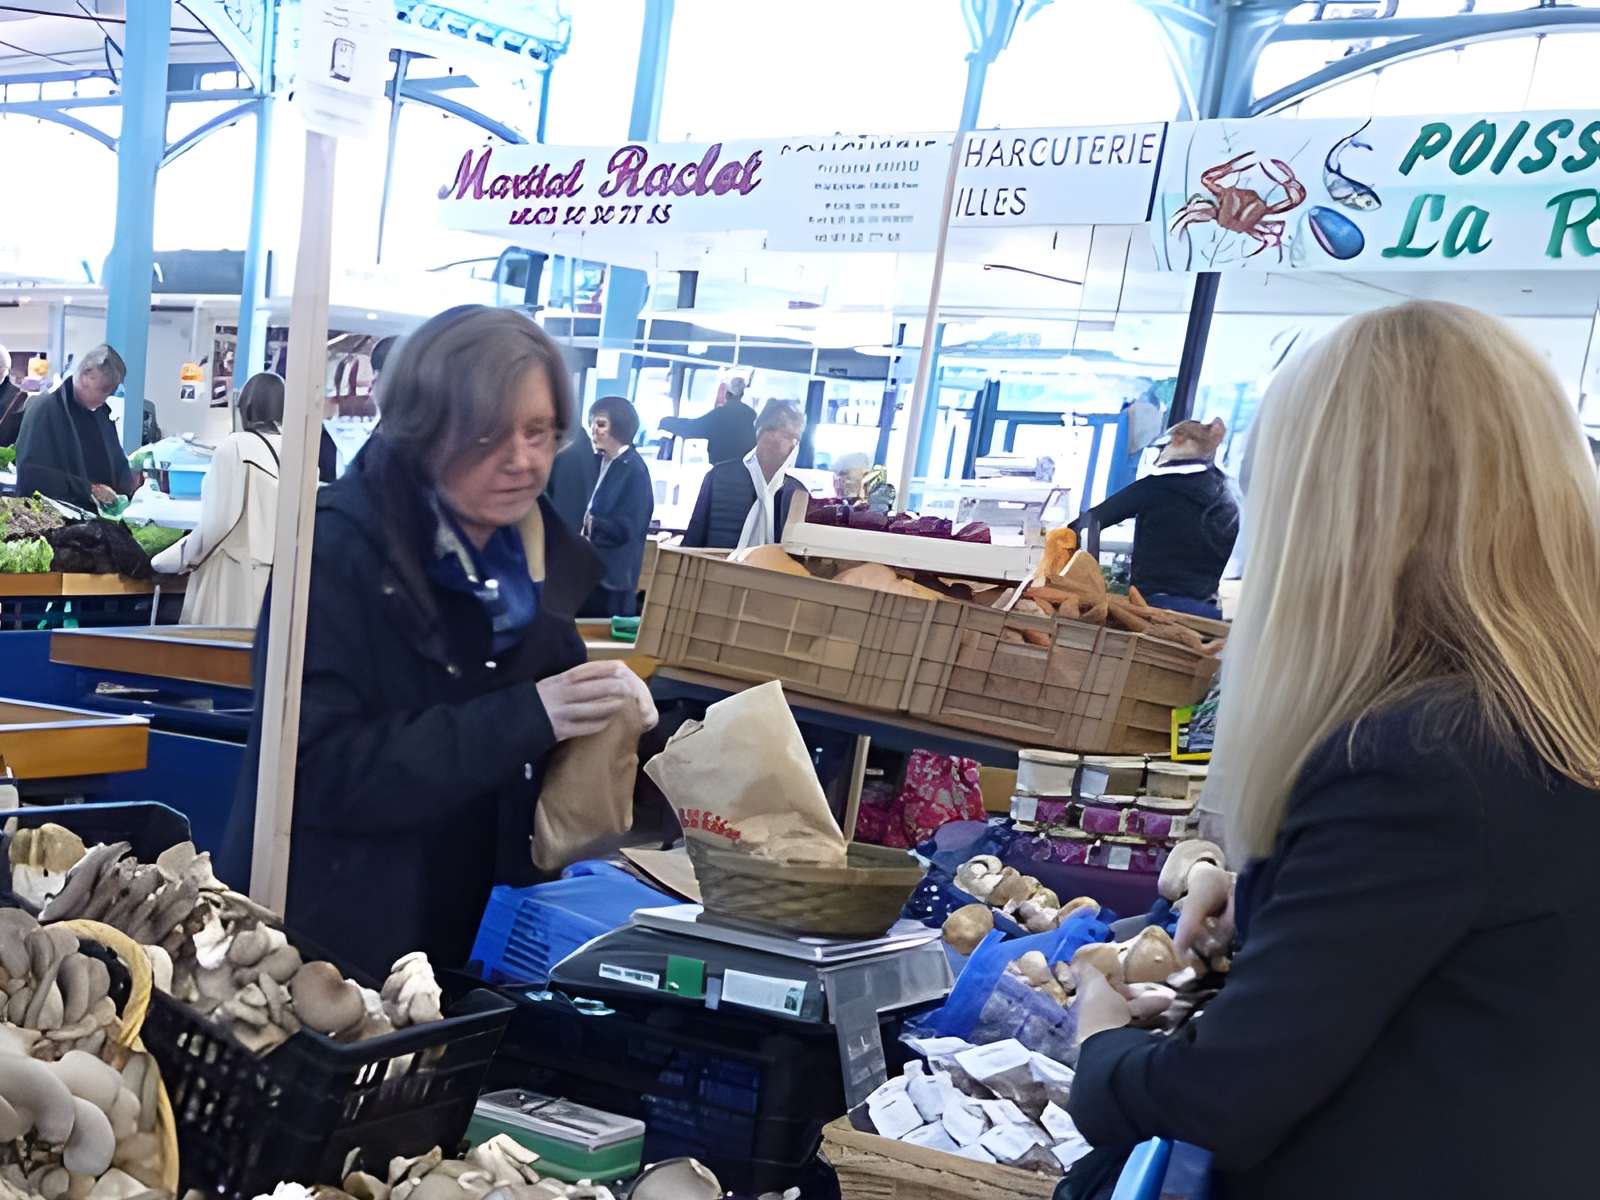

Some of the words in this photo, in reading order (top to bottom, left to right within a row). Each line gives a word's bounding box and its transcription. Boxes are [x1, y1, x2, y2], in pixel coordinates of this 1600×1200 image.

[965, 133, 1157, 167] HARCUTERIE
[1398, 118, 1600, 176] POISS
[1381, 193, 1493, 258] La
